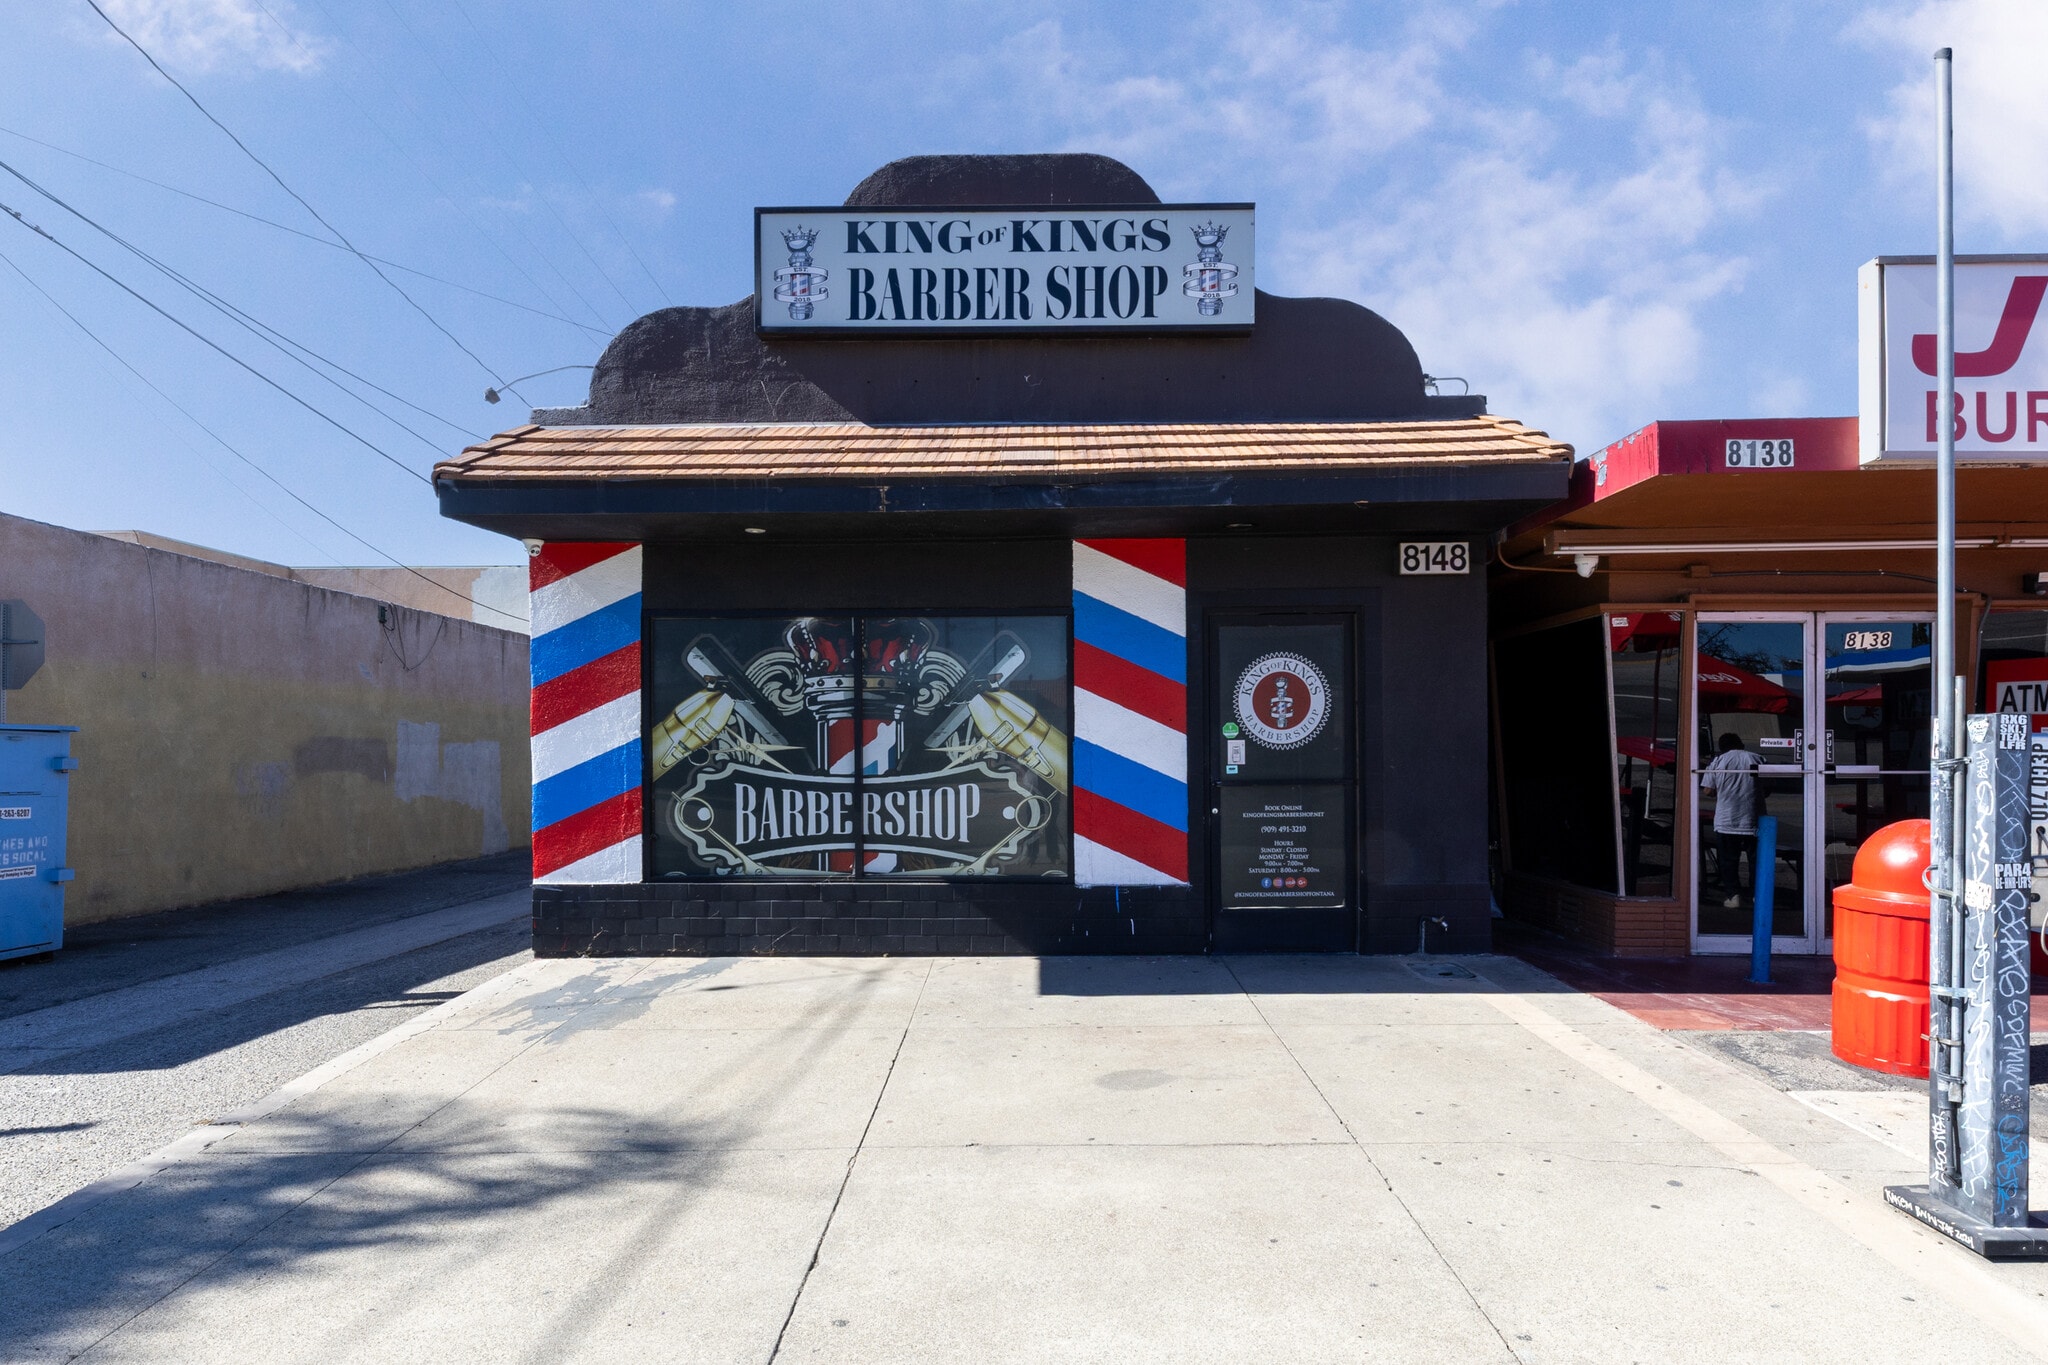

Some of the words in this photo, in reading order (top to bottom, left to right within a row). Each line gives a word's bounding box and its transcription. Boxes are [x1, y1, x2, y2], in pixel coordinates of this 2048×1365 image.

[843, 219, 973, 254] KING
[1008, 218, 1171, 253] KINGS
[846, 266, 1033, 321] BARBER
[1046, 264, 1169, 320] SHOP
[1728, 439, 1792, 467] 8138
[1403, 543, 1467, 572] 8148
[1846, 632, 1891, 649] 8138
[1241, 663, 1271, 696] KING
[1282, 660, 1322, 696] KINGS
[2000, 684, 2048, 712] ATM
[1245, 708, 1320, 741] BARBERSHOP
[734, 782, 981, 846] BARBERSHOP
[1260, 825, 1277, 833] (909)
[1278, 825, 1307, 833] 491-3210
[0, 837, 24, 851] HES
